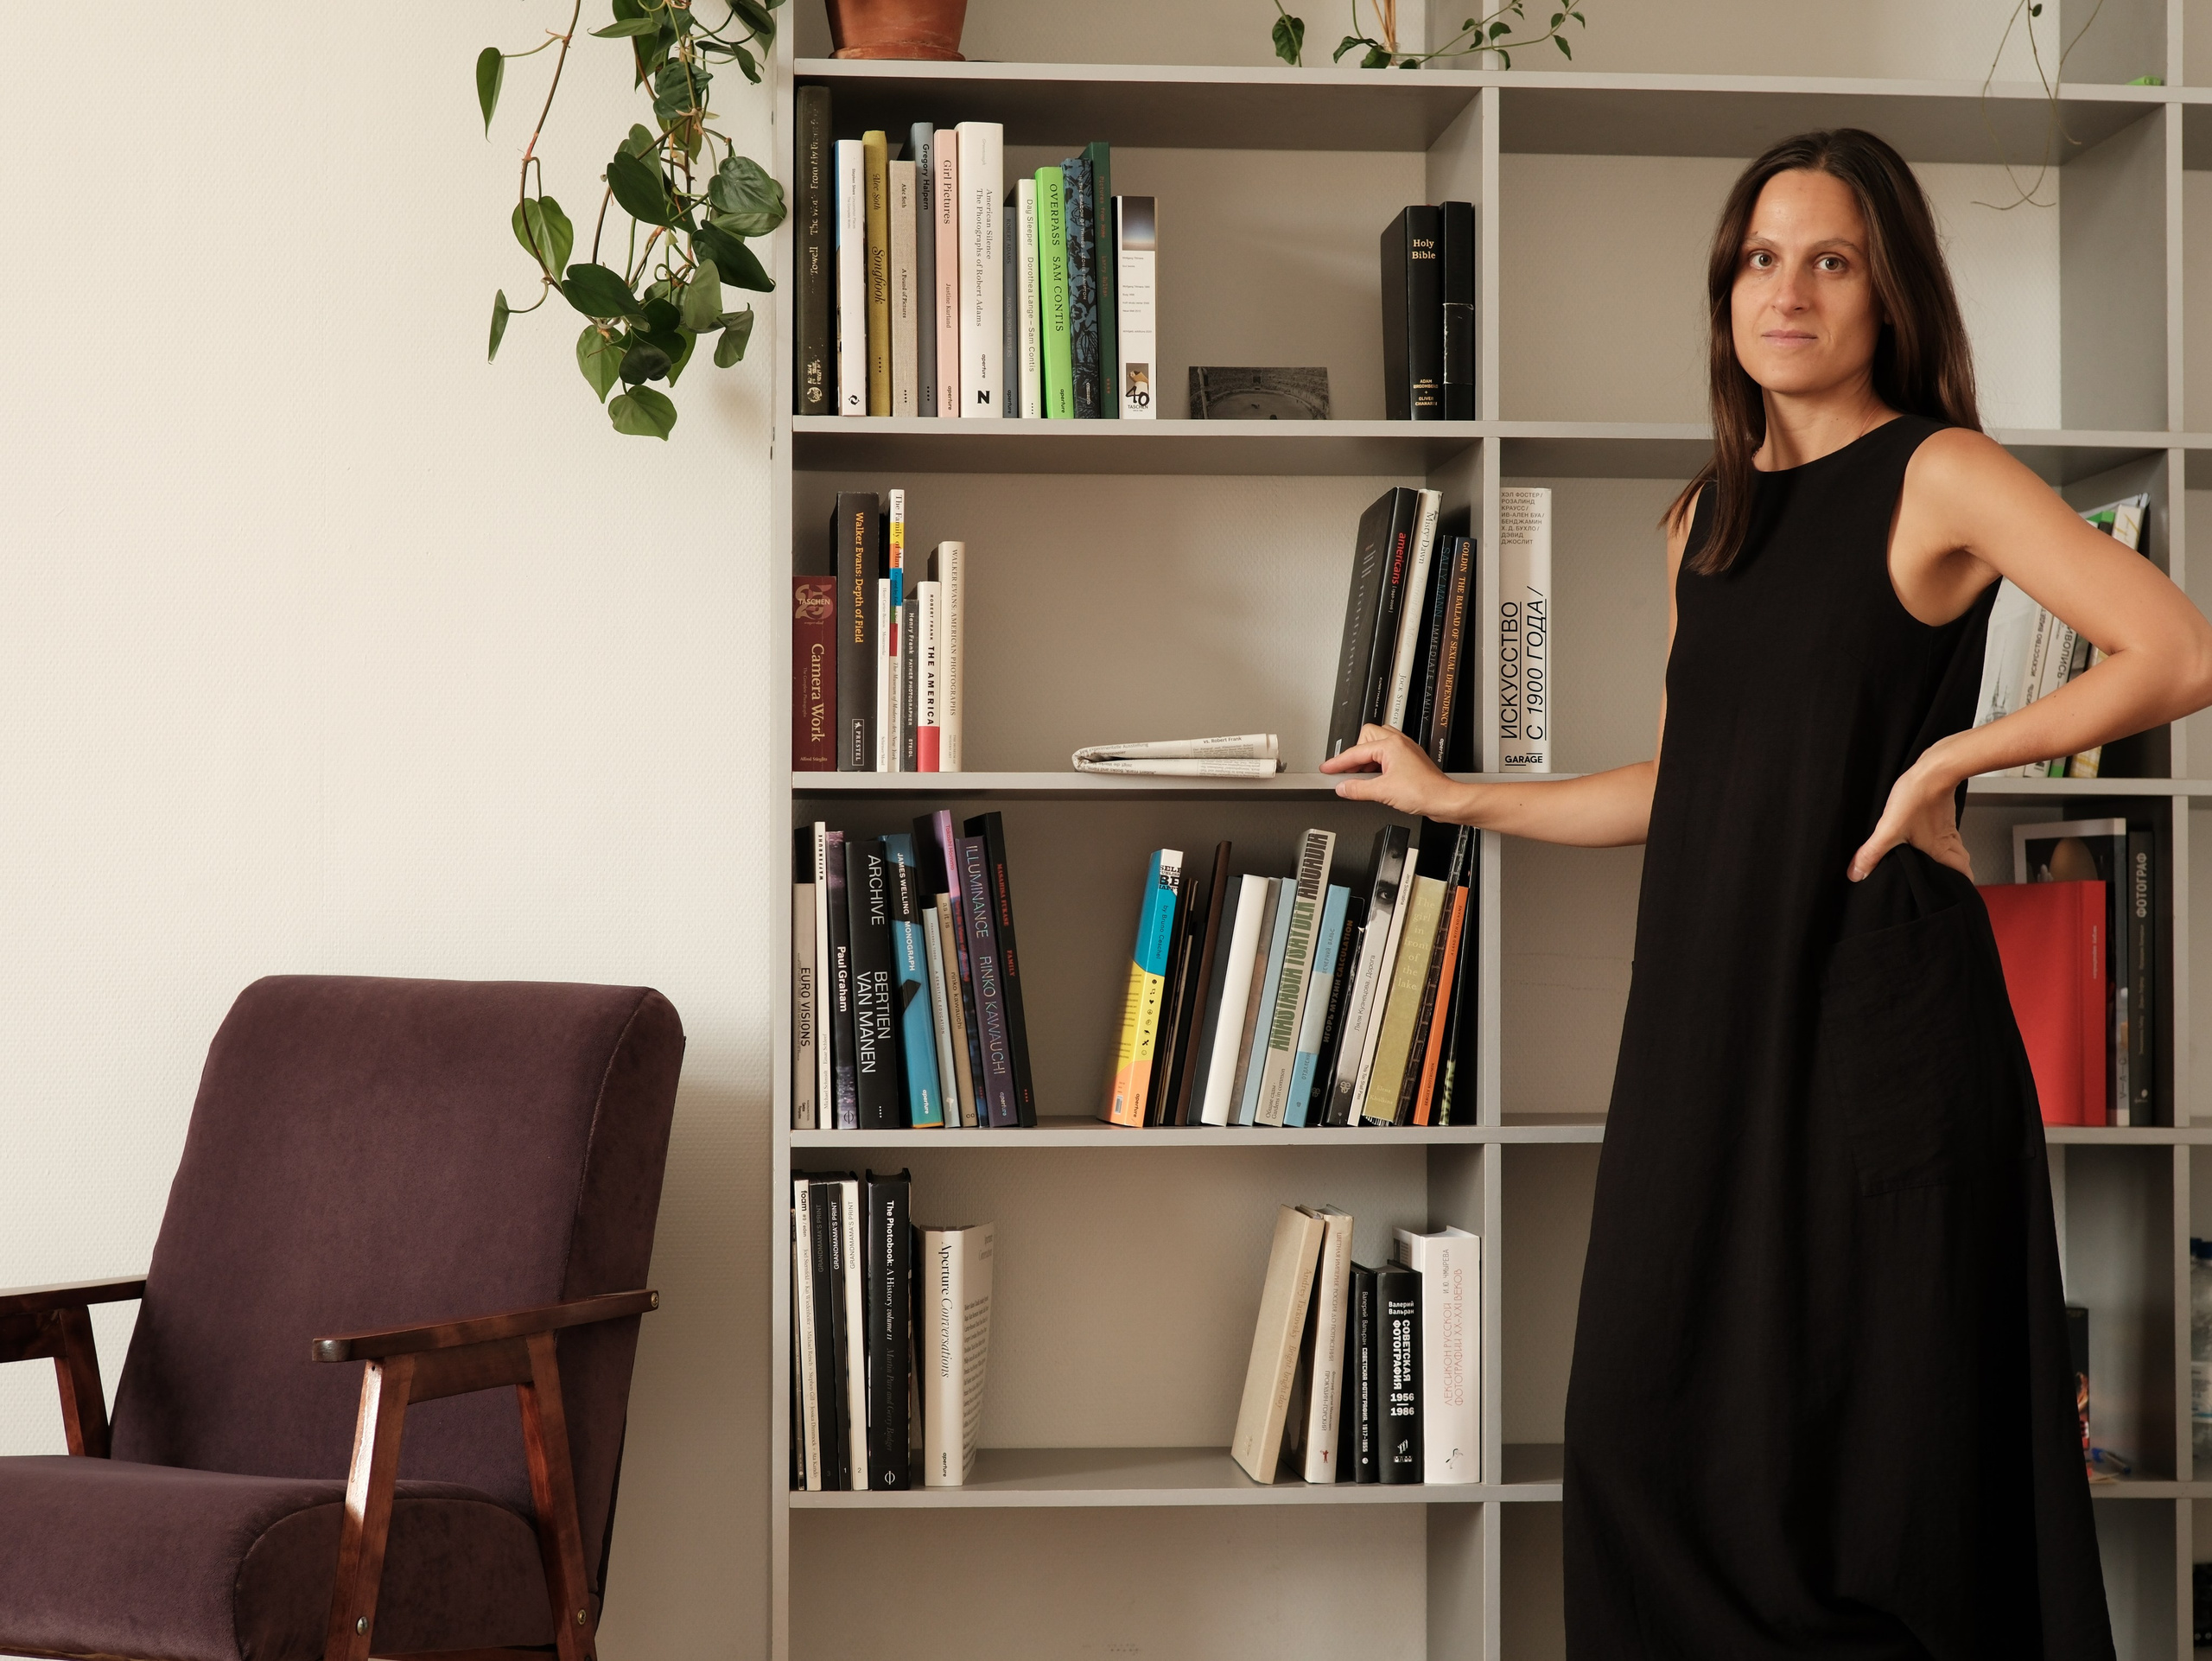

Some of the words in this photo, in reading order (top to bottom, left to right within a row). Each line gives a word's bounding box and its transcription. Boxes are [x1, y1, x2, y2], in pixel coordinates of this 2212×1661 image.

[921, 144, 930, 176] Gregory
[944, 160, 952, 180] Girl
[922, 179, 931, 210] Halpern
[943, 182, 952, 225] Pictures
[1026, 215, 1034, 246] Sleeper
[1049, 183, 1060, 245] OVERPASS
[975, 206, 983, 257] Photographs
[1413, 240, 1434, 249] Holy
[872, 246, 887, 304] Songbook
[1052, 256, 1061, 281] SAM
[1053, 286, 1064, 332] CONTIS
[855, 512, 863, 544] Walker
[893, 512, 903, 539] Family
[1421, 512, 1433, 535] Misty
[1391, 532, 1407, 585] americans
[1418, 539, 1429, 564] Dawn
[1440, 547, 1450, 581] SALLY
[1460, 542, 1470, 572] GOLDIN
[854, 579, 863, 604] Depth
[1434, 584, 1446, 618] MANN
[855, 606, 863, 617] of
[1453, 595, 1464, 627] BALLAD
[1452, 628, 1459, 639] OF
[1527, 601, 1547, 659] ГОДА
[1427, 624, 1439, 680] IMMEDIATE
[1446, 641, 1458, 671] SEXUAL
[811, 644, 824, 699] Camera
[1397, 674, 1406, 692] JOCK
[1501, 601, 1518, 739] ИСКУССТВО
[1423, 686, 1432, 722] FAMILY
[1440, 674, 1453, 728] DEPENDENCY
[1527, 667, 1543, 715] 1900
[811, 703, 825, 742] Work
[1392, 694, 1403, 725] STURGES
[1527, 725, 1543, 740] С
[897, 852, 906, 878] JAMES
[996, 863, 1006, 899] MASAHISA
[1160, 875, 1179, 886] BE
[868, 855, 884, 926] ARCHIVE
[899, 879, 909, 914] WELLING
[965, 845, 988, 938] ILLUMINANCE
[2136, 853, 2147, 918] ФОТОГРАФ
[943, 902, 949, 912] as
[1000, 901, 1009, 926] FUKASE
[837, 946, 847, 969] Paul
[904, 920, 915, 971] MONOGRAPH
[1156, 935, 1165, 959] Ceschel
[979, 957, 995, 997] RINKO
[1006, 950, 1015, 977] FAMILY
[801, 968, 810, 999] EURO
[838, 971, 849, 1012] Graham
[856, 971, 873, 1005] VAN
[1324, 1015, 1336, 1042] ИГОРЬ
[1330, 979, 1341, 1012] МУХИН
[1337, 920, 1353, 977] CALCULATION
[874, 971, 891, 1039] BERTIEN
[953, 993, 963, 1029] kawauchi
[800, 1002, 810, 1047] VISIONS
[859, 1011, 875, 1072] MANEN
[984, 1002, 1005, 1075] KAWAUCHI
[998, 1091, 1007, 1117] aperture
[939, 1242, 952, 1295] Aperture
[885, 1277, 894, 1307] History
[941, 1298, 952, 1378] Conversations
[1393, 1320, 1402, 1390] ФОТОГРАФИЯ
[1402, 1320, 1411, 1381] СОВЕТСКАЯ
[1390, 1407, 1414, 1416] 1986
